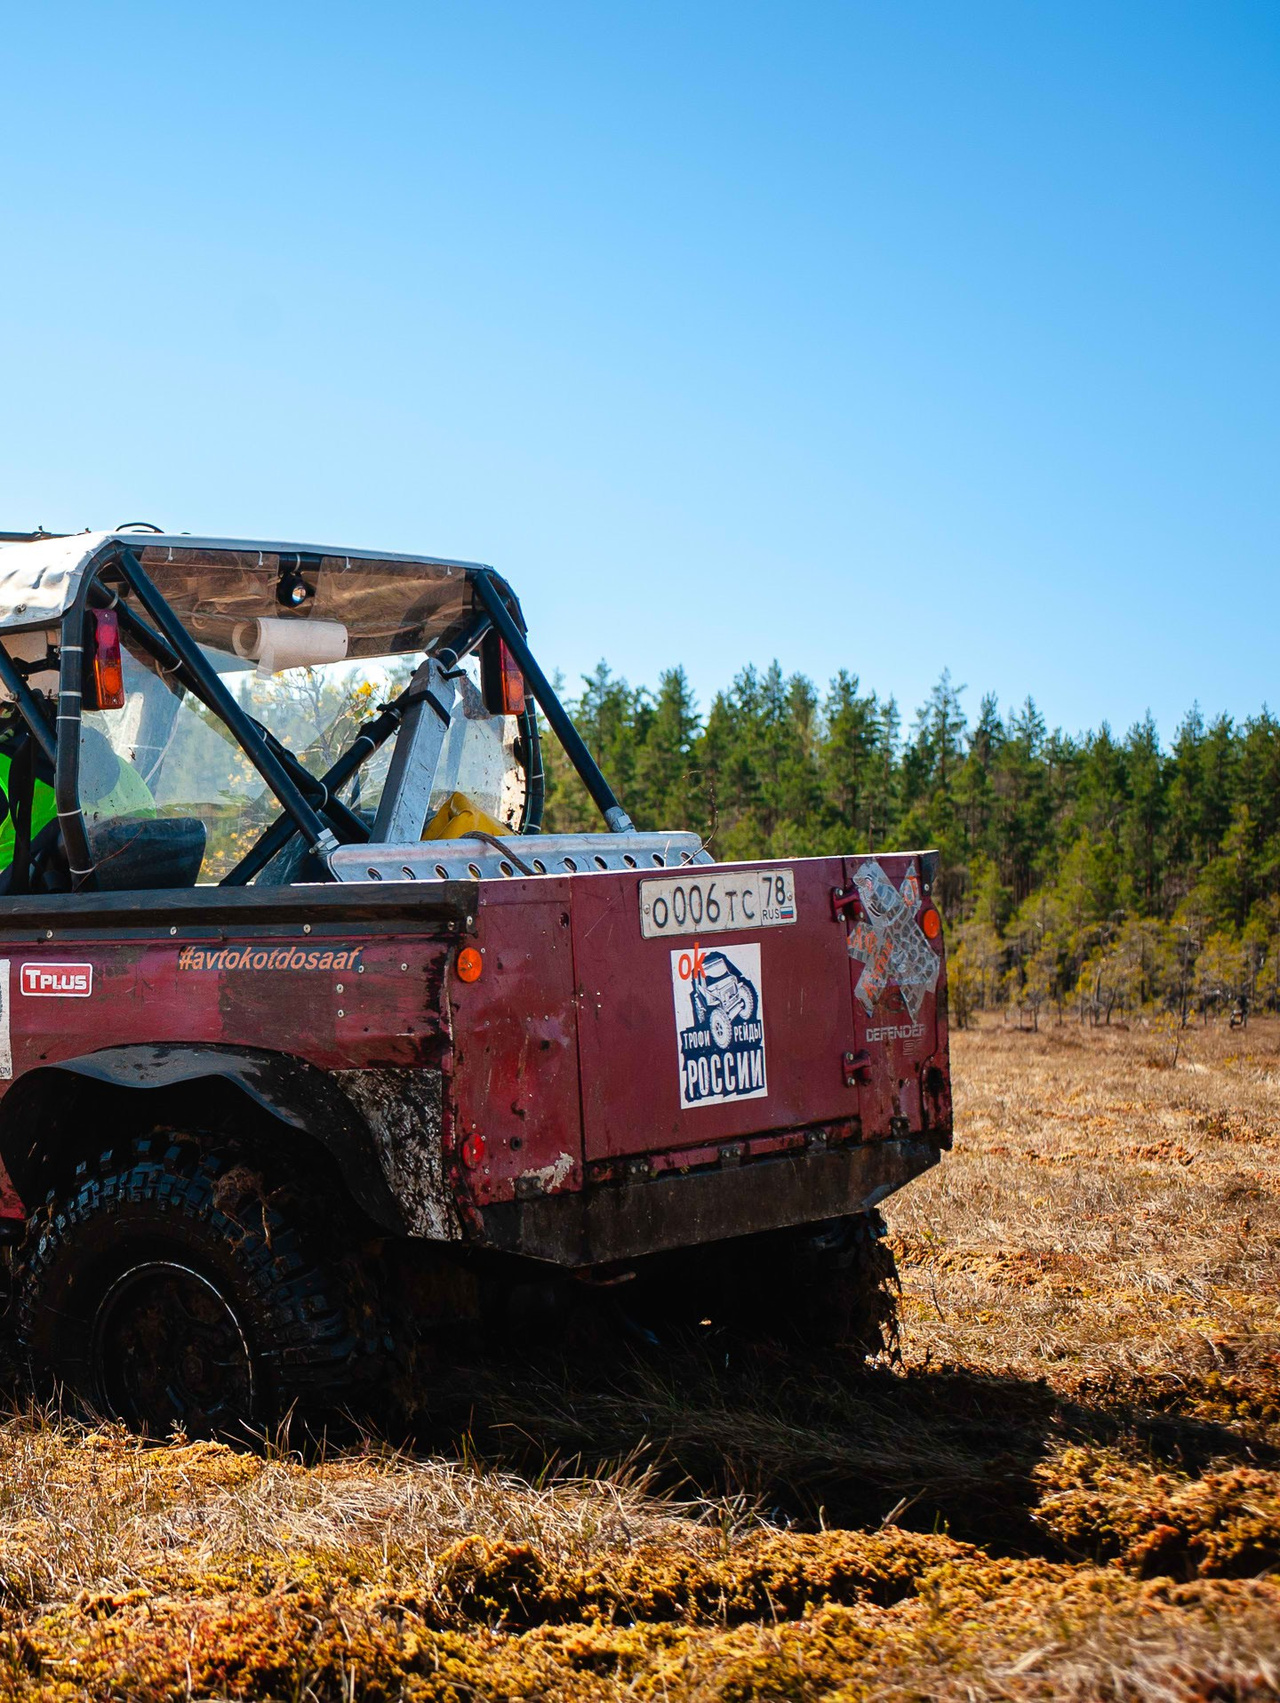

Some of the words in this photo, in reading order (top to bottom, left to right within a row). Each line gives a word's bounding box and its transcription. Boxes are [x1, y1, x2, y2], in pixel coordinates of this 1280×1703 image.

[762, 876, 785, 907] 78
[762, 908, 780, 920] RUS
[25, 969, 87, 990] TPLUS
[683, 1030, 711, 1050] ТРОФИ
[733, 1021, 762, 1043] РЕЙДЫ
[687, 1049, 763, 1098] РОССИИ
